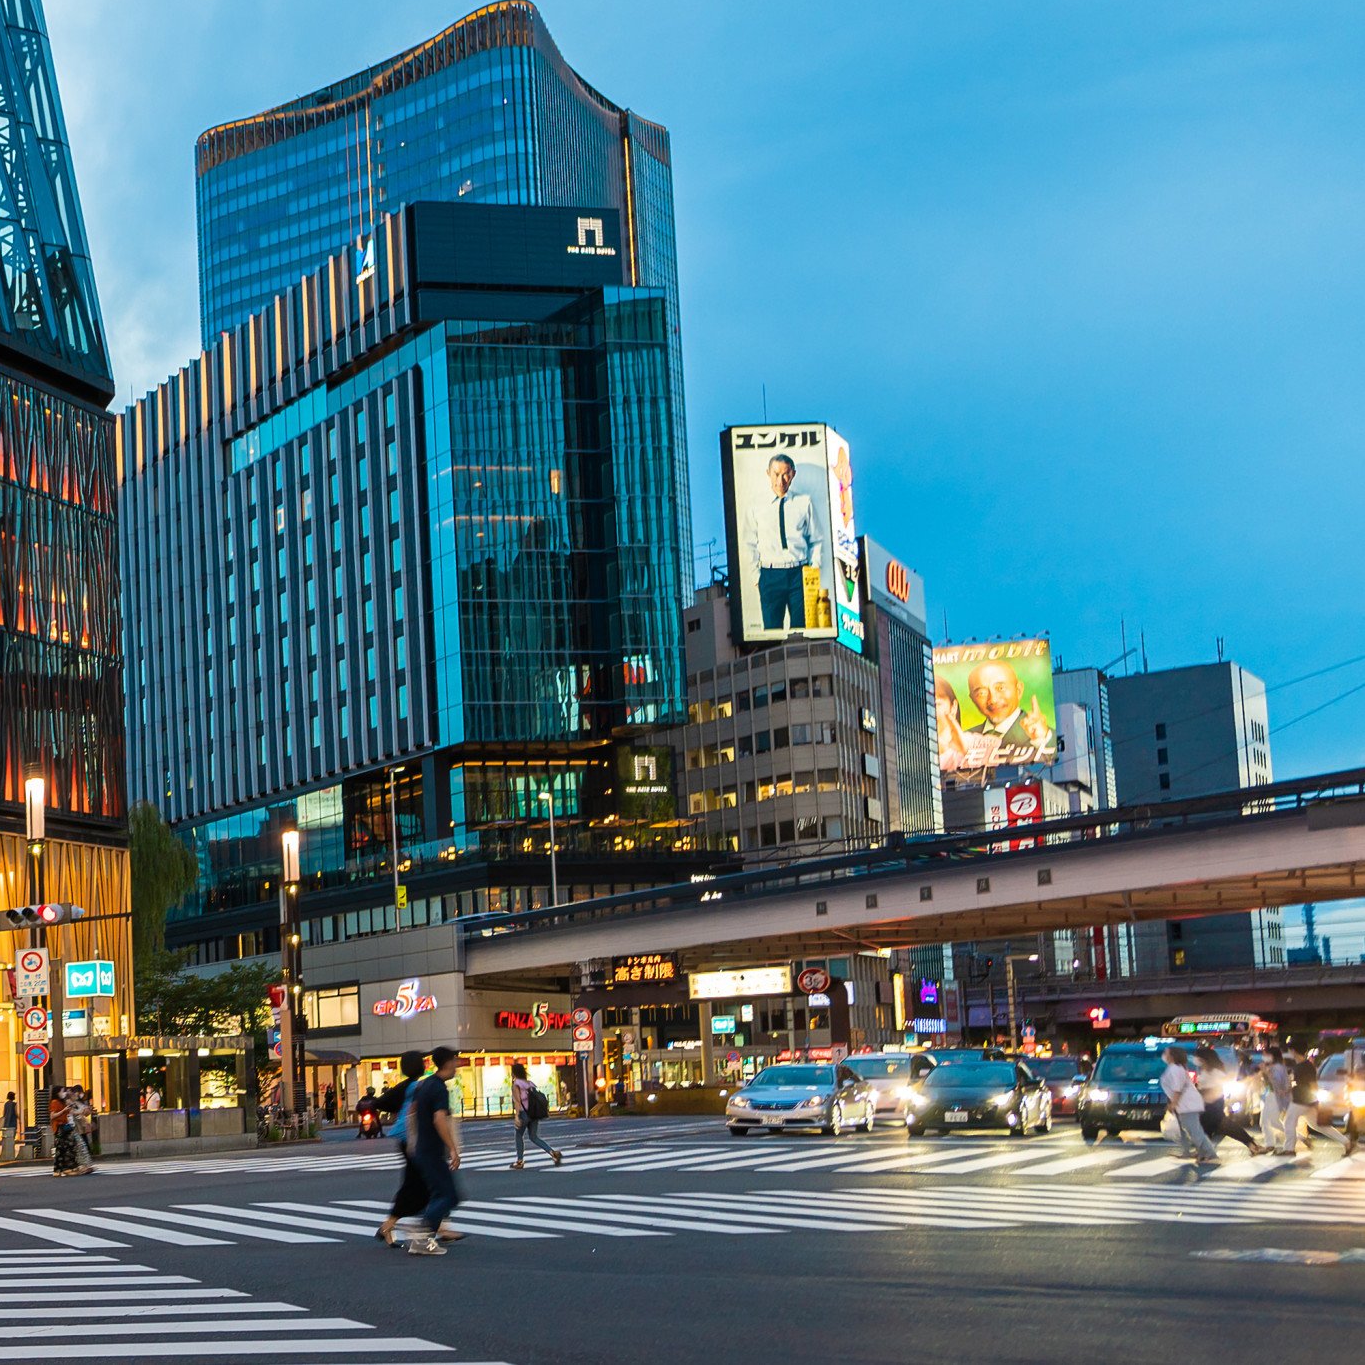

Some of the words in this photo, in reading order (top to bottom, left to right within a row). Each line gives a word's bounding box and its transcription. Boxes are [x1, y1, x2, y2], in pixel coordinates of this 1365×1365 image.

[735, 431, 821, 450] ユンケル
[961, 639, 1048, 663] mobit
[962, 743, 1056, 765] モビット
[614, 962, 675, 982] 高さ制限
[395, 981, 419, 1017] 5
